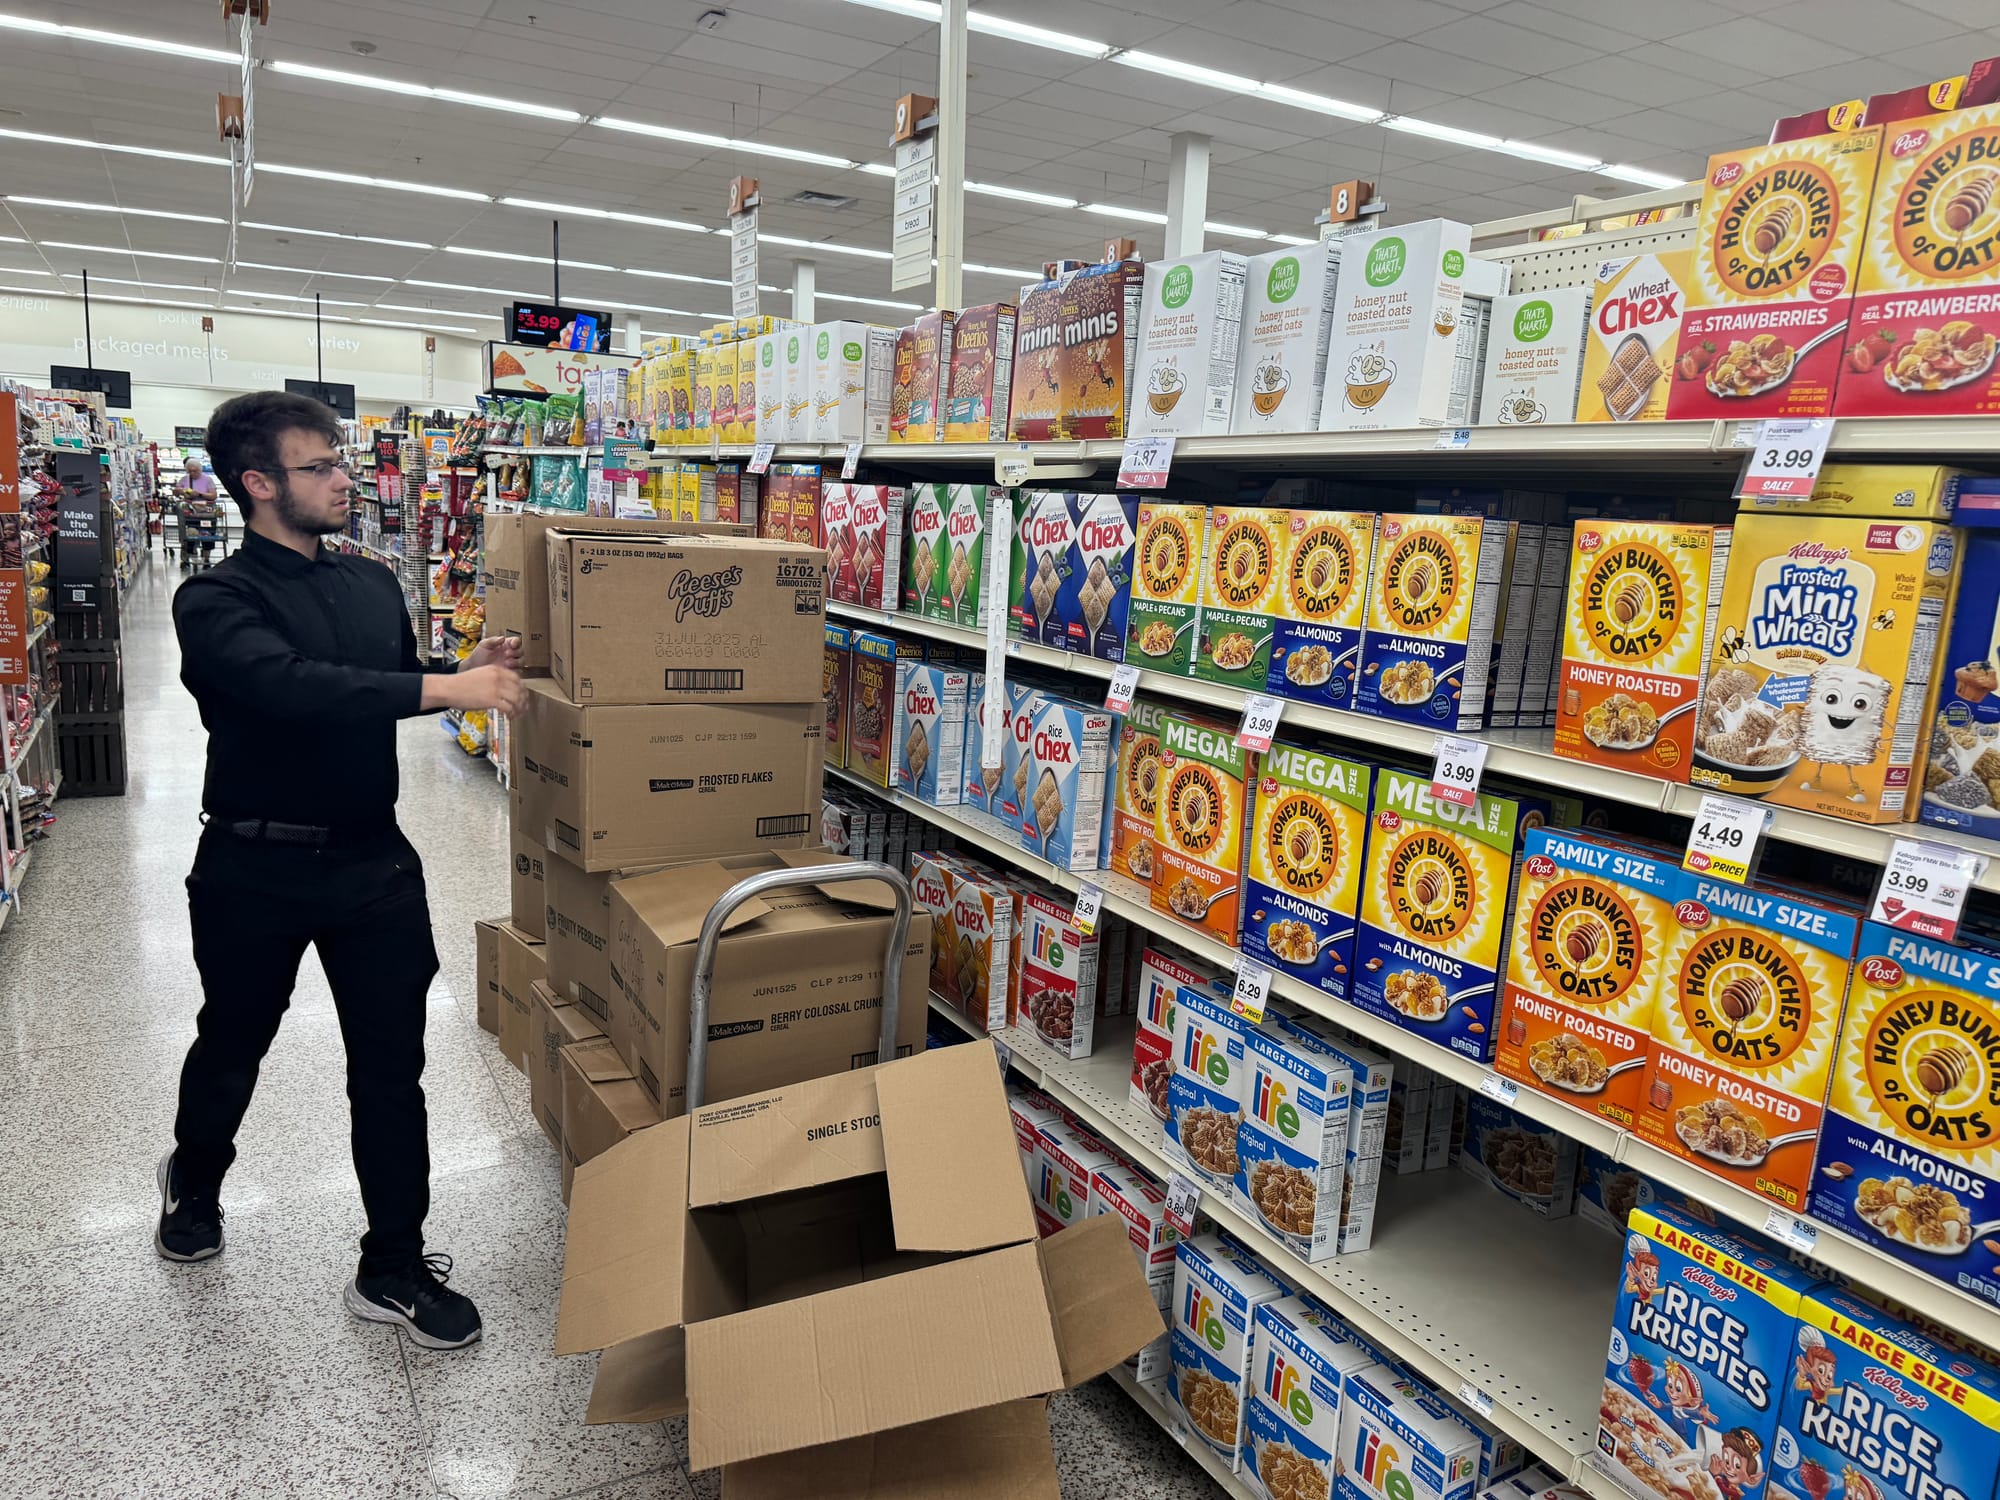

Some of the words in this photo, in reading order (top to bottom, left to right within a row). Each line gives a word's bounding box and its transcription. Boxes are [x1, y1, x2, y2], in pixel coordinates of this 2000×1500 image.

[897, 104, 906, 133] 9
[1894, 132, 1926, 151] Post
[1714, 164, 1740, 183] Post
[730, 184, 737, 206] 9
[1336, 189, 1348, 214] 8
[1722, 176, 1767, 250] HONEY
[1772, 169, 1831, 238] BUNCHES
[905, 217, 919, 230] bread
[1324, 229, 1350, 240] parmesan
[1351, 224, 1373, 235] cheese
[1108, 245, 1115, 262] 8
[1375, 245, 1398, 260] THAT'S
[1745, 248, 1811, 290] OATS
[1629, 278, 1671, 301] Wheat
[1354, 294, 1388, 308] honey
[1389, 292, 1408, 304] nut
[158, 312, 188, 325] pork
[518, 313, 560, 329] $3.99
[1348, 307, 1387, 323] toasted
[1388, 305, 1412, 317] oats
[1599, 291, 1679, 335] Chex
[1705, 308, 1828, 333] STRAWBERRIES
[1065, 310, 1118, 347] minis
[74, 336, 167, 357] packaged
[173, 343, 229, 360] meats
[307, 335, 360, 352] variety
[956, 329, 988, 349] Cheerios
[1454, 431, 1470, 440] 5.48
[377, 442, 394, 450] RED
[1134, 450, 1157, 466] 1.87
[1763, 449, 1813, 468] 3.99
[1762, 480, 1794, 490] SALE!
[64, 511, 94, 520] Make
[825, 504, 848, 524] Chex
[921, 501, 933, 512] Corn
[959, 503, 971, 515] Corn
[1045, 511, 1067, 522] Blueberry
[69, 520, 88, 529] the
[853, 507, 880, 527] Chex
[913, 510, 940, 533] Chex
[1096, 515, 1123, 526] Blueberry
[60, 529, 98, 538] switch.
[1870, 536, 1892, 545] FIBER
[1872, 530, 1892, 538] HIGH
[612, 549, 621, 557] OZ
[1788, 542, 1848, 564] Kellogg's
[777, 565, 814, 577] 16702
[1784, 568, 1844, 589] Frosted
[1895, 573, 1916, 583] Whole
[668, 566, 743, 600] Reese's
[776, 579, 822, 588] GMI0016702
[1896, 583, 1914, 592] Grain
[676, 589, 734, 623] Puffs
[1768, 588, 1853, 622] Mini
[1892, 592, 1913, 601] Cereal
[1133, 601, 1153, 613] MAPLE
[1158, 605, 1186, 617] PECANS
[1294, 625, 1342, 643] ALMONDS
[1756, 616, 1853, 653] Wheats
[860, 638, 876, 653] GIANT
[876, 643, 888, 656] SIZE
[1389, 638, 1446, 658] ALMONDS
[1776, 649, 1801, 661] Golden
[1803, 650, 1827, 664] Honey
[15, 657, 23, 674] STEP
[917, 683, 928, 695] Rice
[1114, 682, 1131, 697] 3.99
[1570, 665, 1618, 686] HONEY
[1616, 673, 1682, 698] ROASTED
[1048, 724, 1062, 738] Rice
[1249, 716, 1272, 732] 3.99
[699, 774, 739, 786] FROSTED
[741, 771, 773, 784] FLAKES
[1267, 747, 1345, 795] MEGA
[1348, 768, 1358, 795] SIZE
[1442, 762, 1474, 783] 3.99
[1487, 803, 1500, 834] SIZE
[1698, 822, 1743, 848] 4.49
[1544, 839, 1609, 872] FAMILY
[1612, 858, 1655, 883] SIZE
[1691, 855, 1709, 868] LOW
[1712, 861, 1745, 878] PRICE!
[1888, 871, 1928, 893] 3.99
[1939, 890, 1955, 899] .50
[1033, 899, 1055, 916] LARGE
[1056, 909, 1071, 921] SIZE
[1077, 899, 1094, 916] 6.29
[1696, 883, 1769, 919] FAMILY
[1776, 906, 1827, 936] SIZE
[558, 912, 577, 936] FRUITY
[578, 924, 603, 952] PEBBLES
[1536, 887, 1578, 942] HONEY
[1580, 886, 1635, 971] BUNCHES
[1912, 921, 1944, 936] DECLINE
[1032, 921, 1064, 968] life
[752, 984, 797, 997] JUN1525
[810, 977, 832, 988] CLP
[838, 973, 863, 984] 21:29
[1238, 979, 1261, 1000] 6.29
[771, 1010, 802, 1024] BERRY
[804, 1001, 851, 1019] COLOSSAL
[1186, 996, 1216, 1020] LARGE
[1217, 1011, 1240, 1030] SIZE
[1183, 1024, 1229, 1086] life
[1254, 1039, 1286, 1065] LARGE
[1287, 1058, 1310, 1079] SIZE
[1171, 1081, 1197, 1101] original
[1501, 1080, 1517, 1093] 4.98
[807, 1121, 848, 1141] SINGLE
[1239, 1130, 1266, 1153] original
[1166, 1198, 1184, 1218] 3.89
[1793, 1220, 1816, 1237] 4.98
[1654, 1224, 1716, 1273] LARGE
[1722, 1260, 1768, 1294] SIZE
[1665, 1288, 1745, 1354] RICE
[1629, 1301, 1768, 1409] KRISPIES
[1360, 1415, 1381, 1434] QUAKER
[1842, 1385, 1938, 1462] RICE
